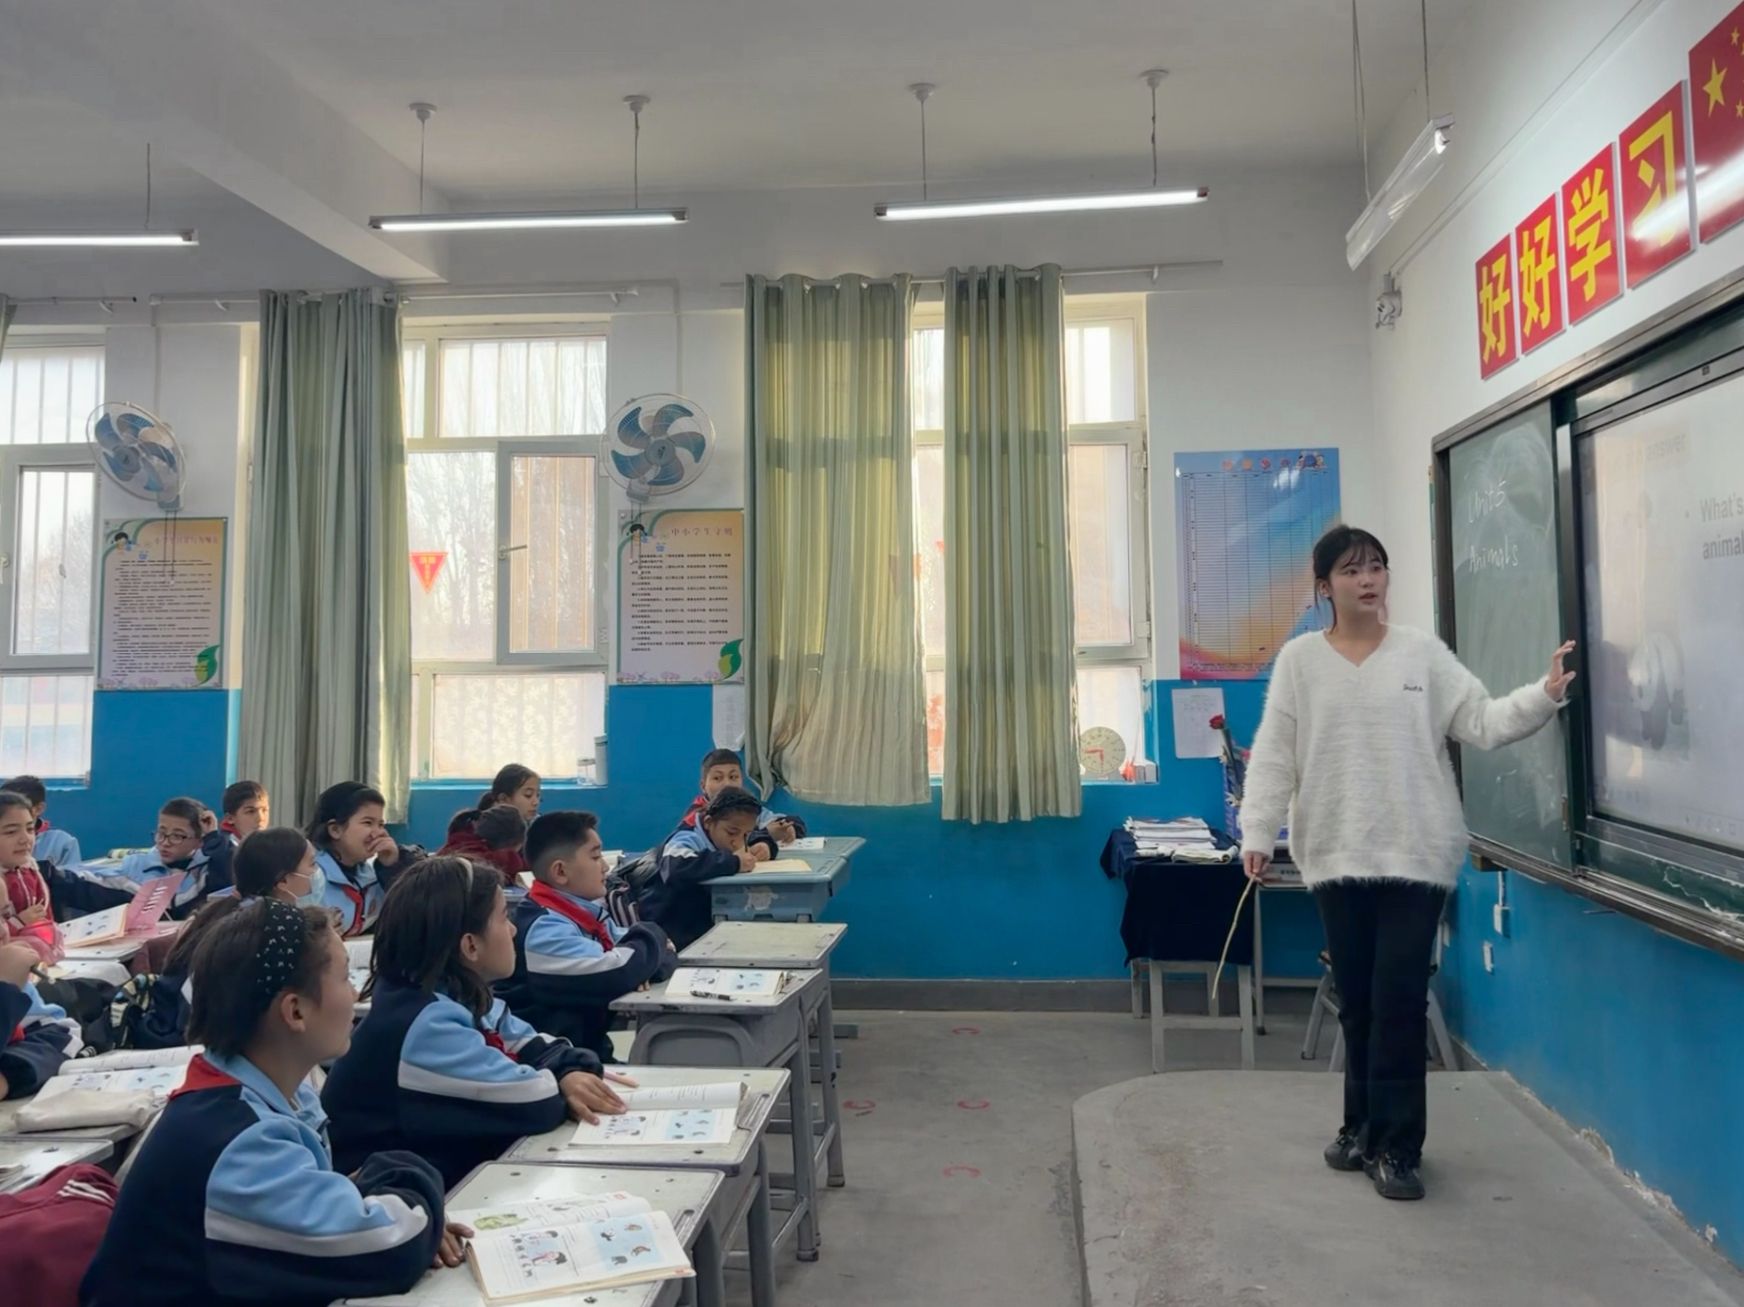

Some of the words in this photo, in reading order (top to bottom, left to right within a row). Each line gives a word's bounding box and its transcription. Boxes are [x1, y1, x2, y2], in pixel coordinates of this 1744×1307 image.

[1479, 110, 1677, 365] 好好学习
[1699, 492, 1744, 523] What's
